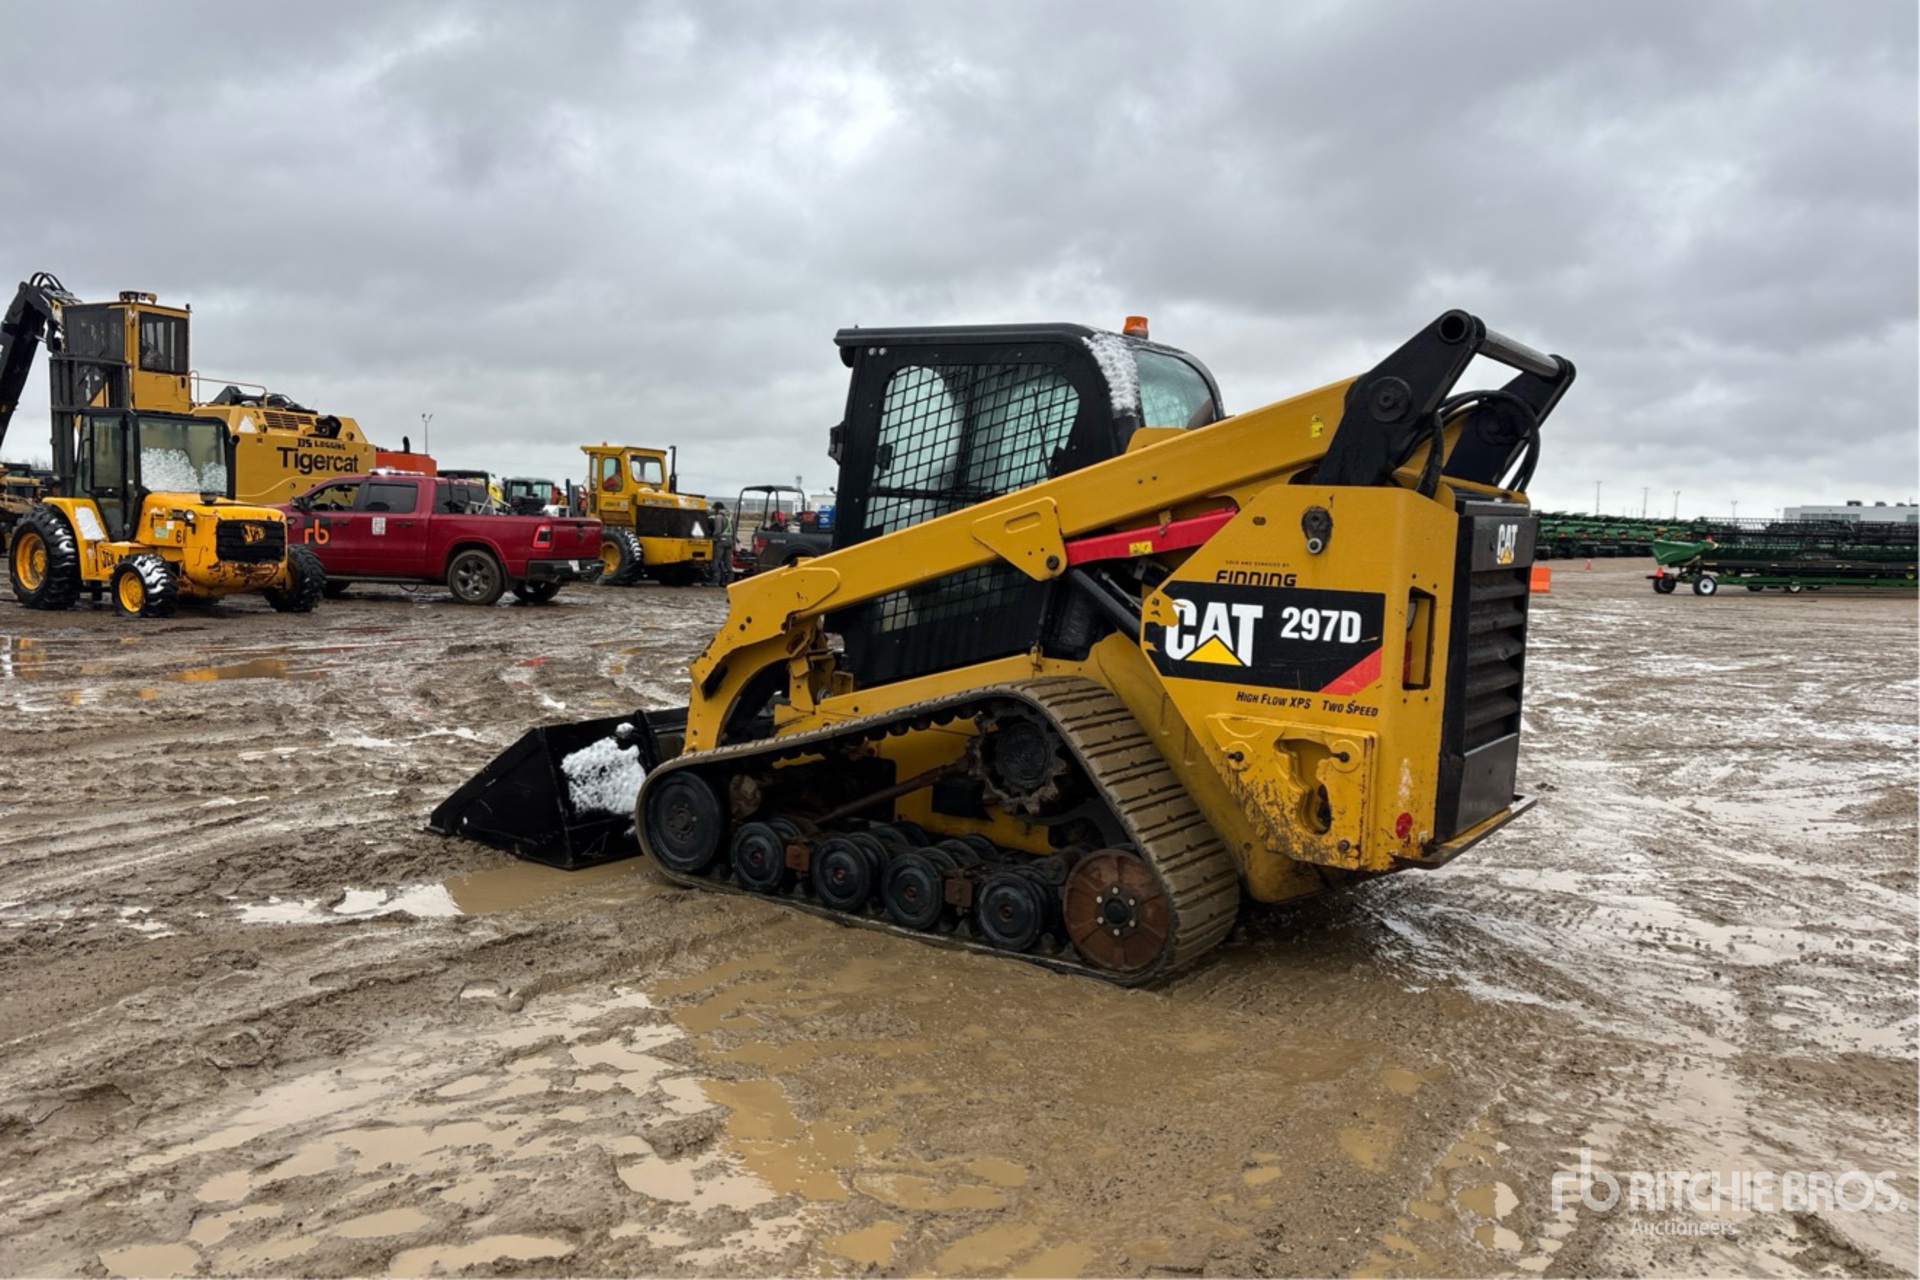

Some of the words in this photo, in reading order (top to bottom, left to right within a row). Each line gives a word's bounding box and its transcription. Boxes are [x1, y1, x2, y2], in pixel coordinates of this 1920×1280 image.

[277, 446, 359, 475] Tigercat
[304, 519, 329, 545] rb
[1497, 524, 1518, 564] CAT
[1165, 599, 1263, 667] CAT
[1280, 607, 1362, 643] 297D
[1289, 697, 1312, 709] XPS
